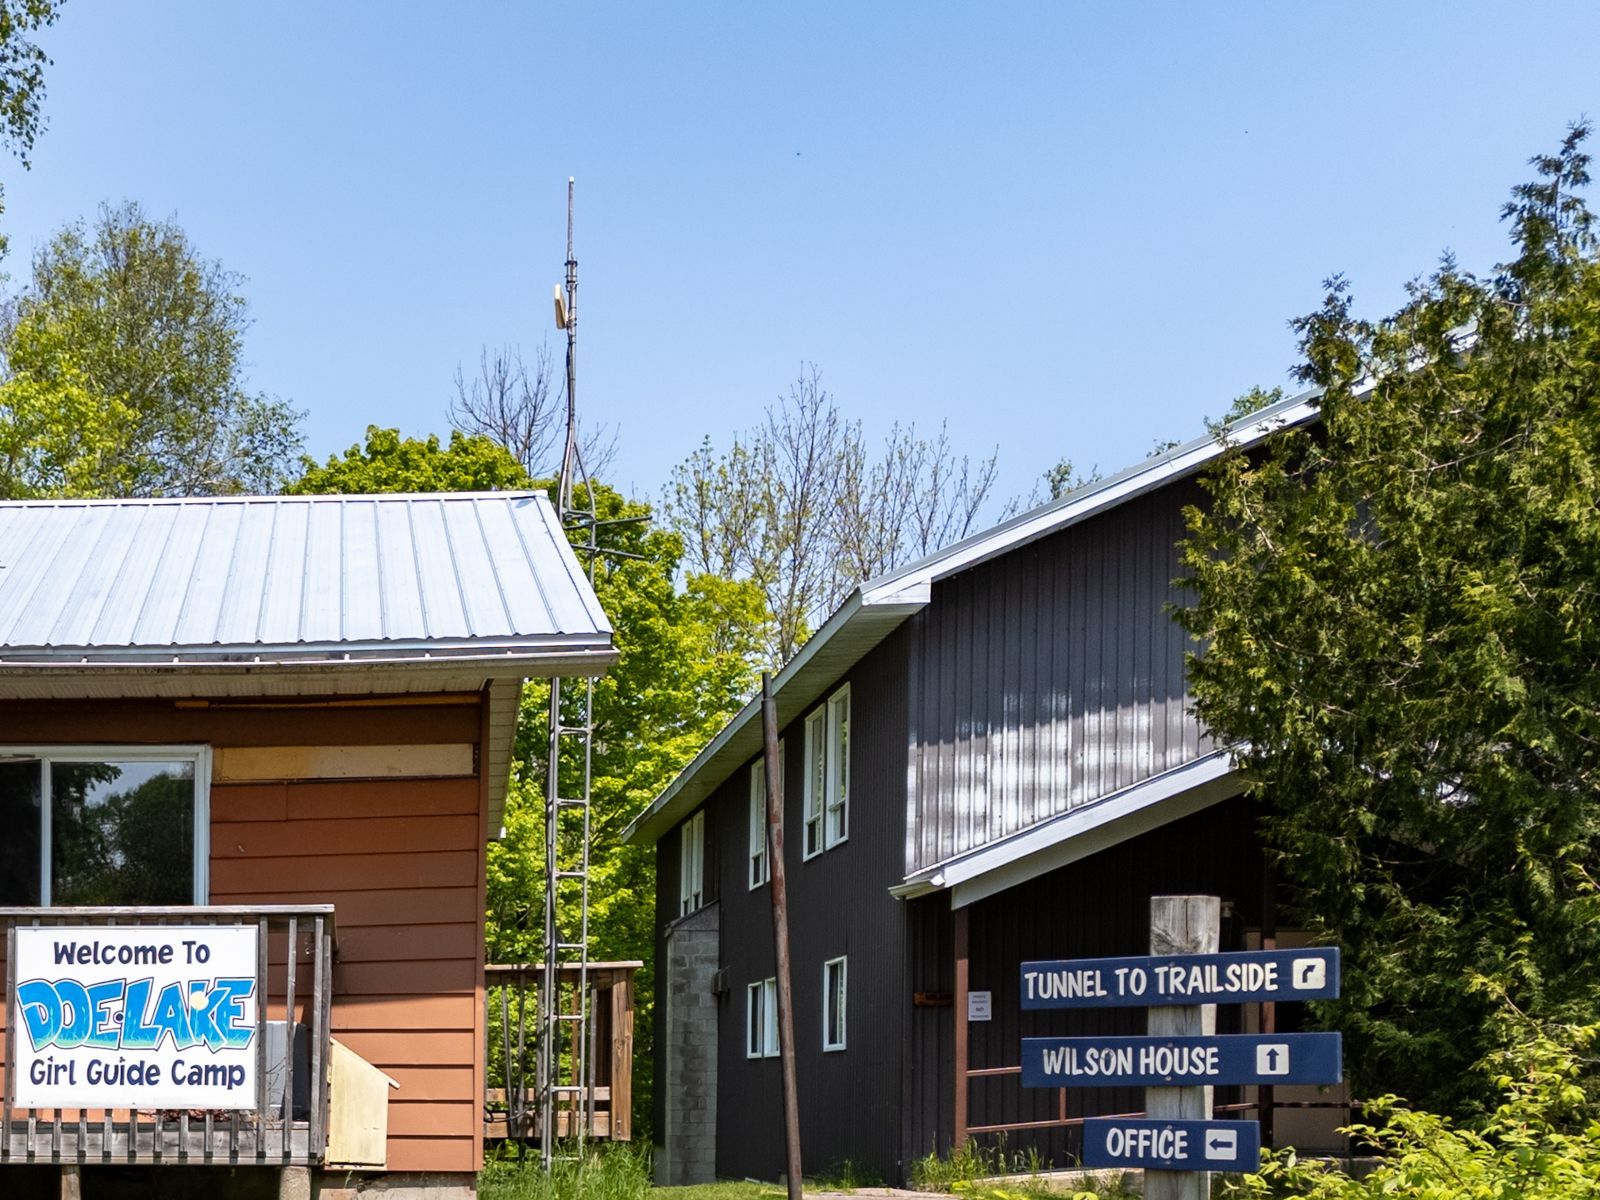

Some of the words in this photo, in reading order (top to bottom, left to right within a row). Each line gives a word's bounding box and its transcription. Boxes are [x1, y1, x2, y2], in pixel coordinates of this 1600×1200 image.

[54, 941, 173, 965] Welcome
[182, 941, 211, 964] To
[1024, 970, 1107, 1000] TUNNEL
[1115, 968, 1147, 996] TO
[1155, 962, 1279, 995] TRAILSIDE
[30, 1056, 76, 1086] Girl
[86, 1056, 161, 1087] Guide
[171, 1059, 246, 1090] Camp
[1043, 1046, 1133, 1076] WILSON
[1139, 1046, 1219, 1076] HOUSE
[1106, 1127, 1188, 1159] OFFICE
